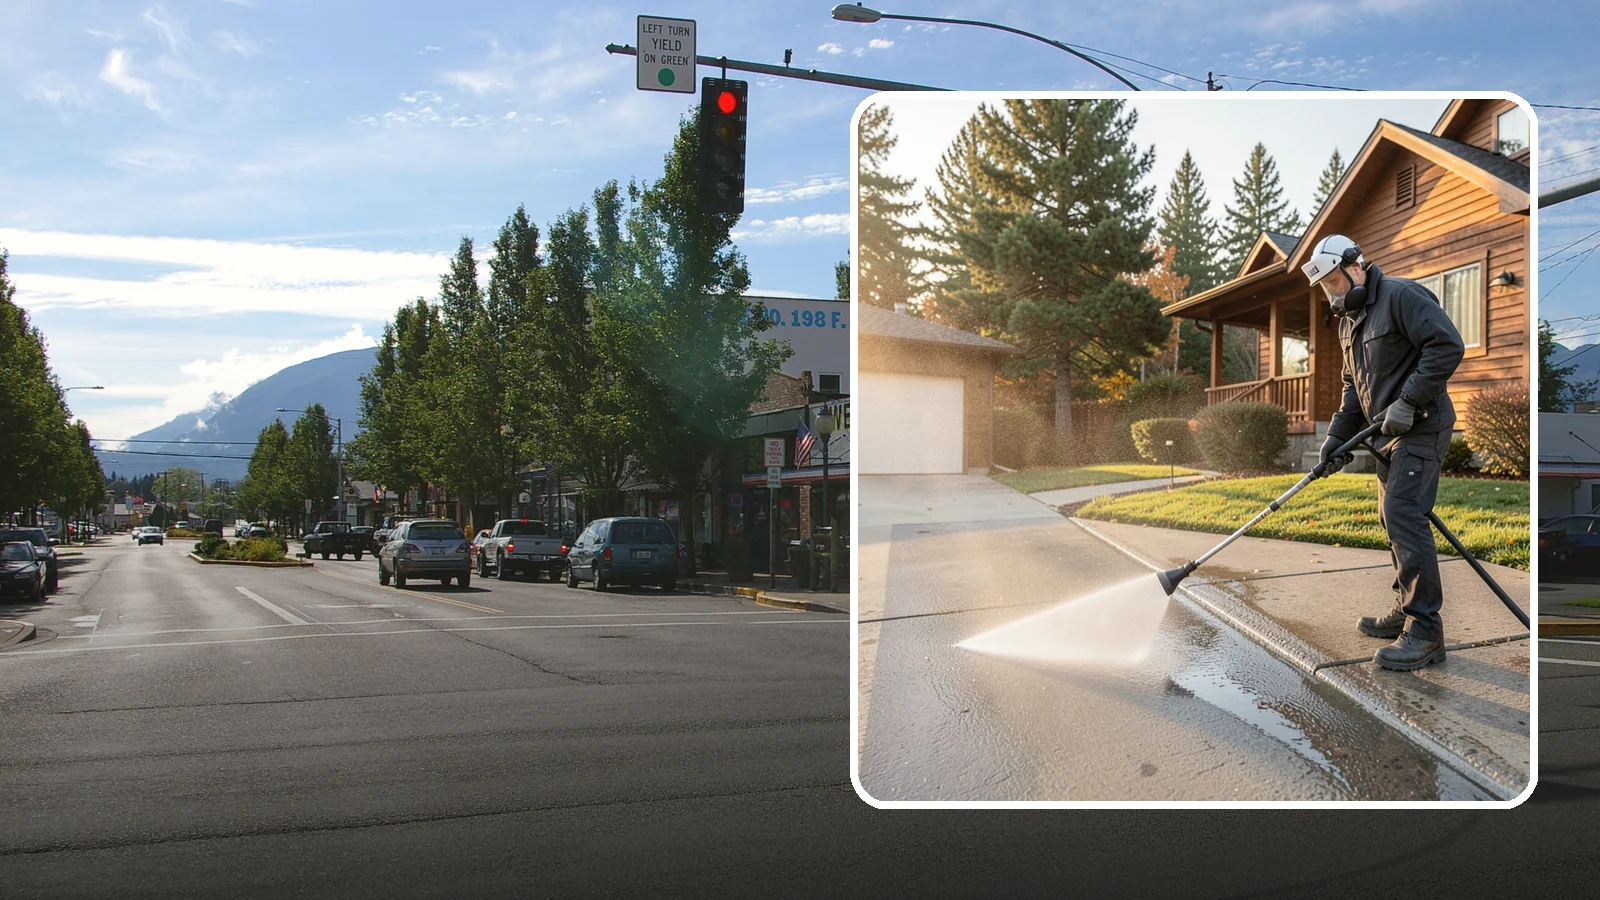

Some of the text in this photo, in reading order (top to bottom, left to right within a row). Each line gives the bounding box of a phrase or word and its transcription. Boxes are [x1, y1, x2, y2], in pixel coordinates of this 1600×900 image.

[642, 23, 690, 36] LEFT TURN
[652, 38, 682, 51] YIELD
[791, 309, 826, 328] 198
[831, 311, 847, 329] F.
